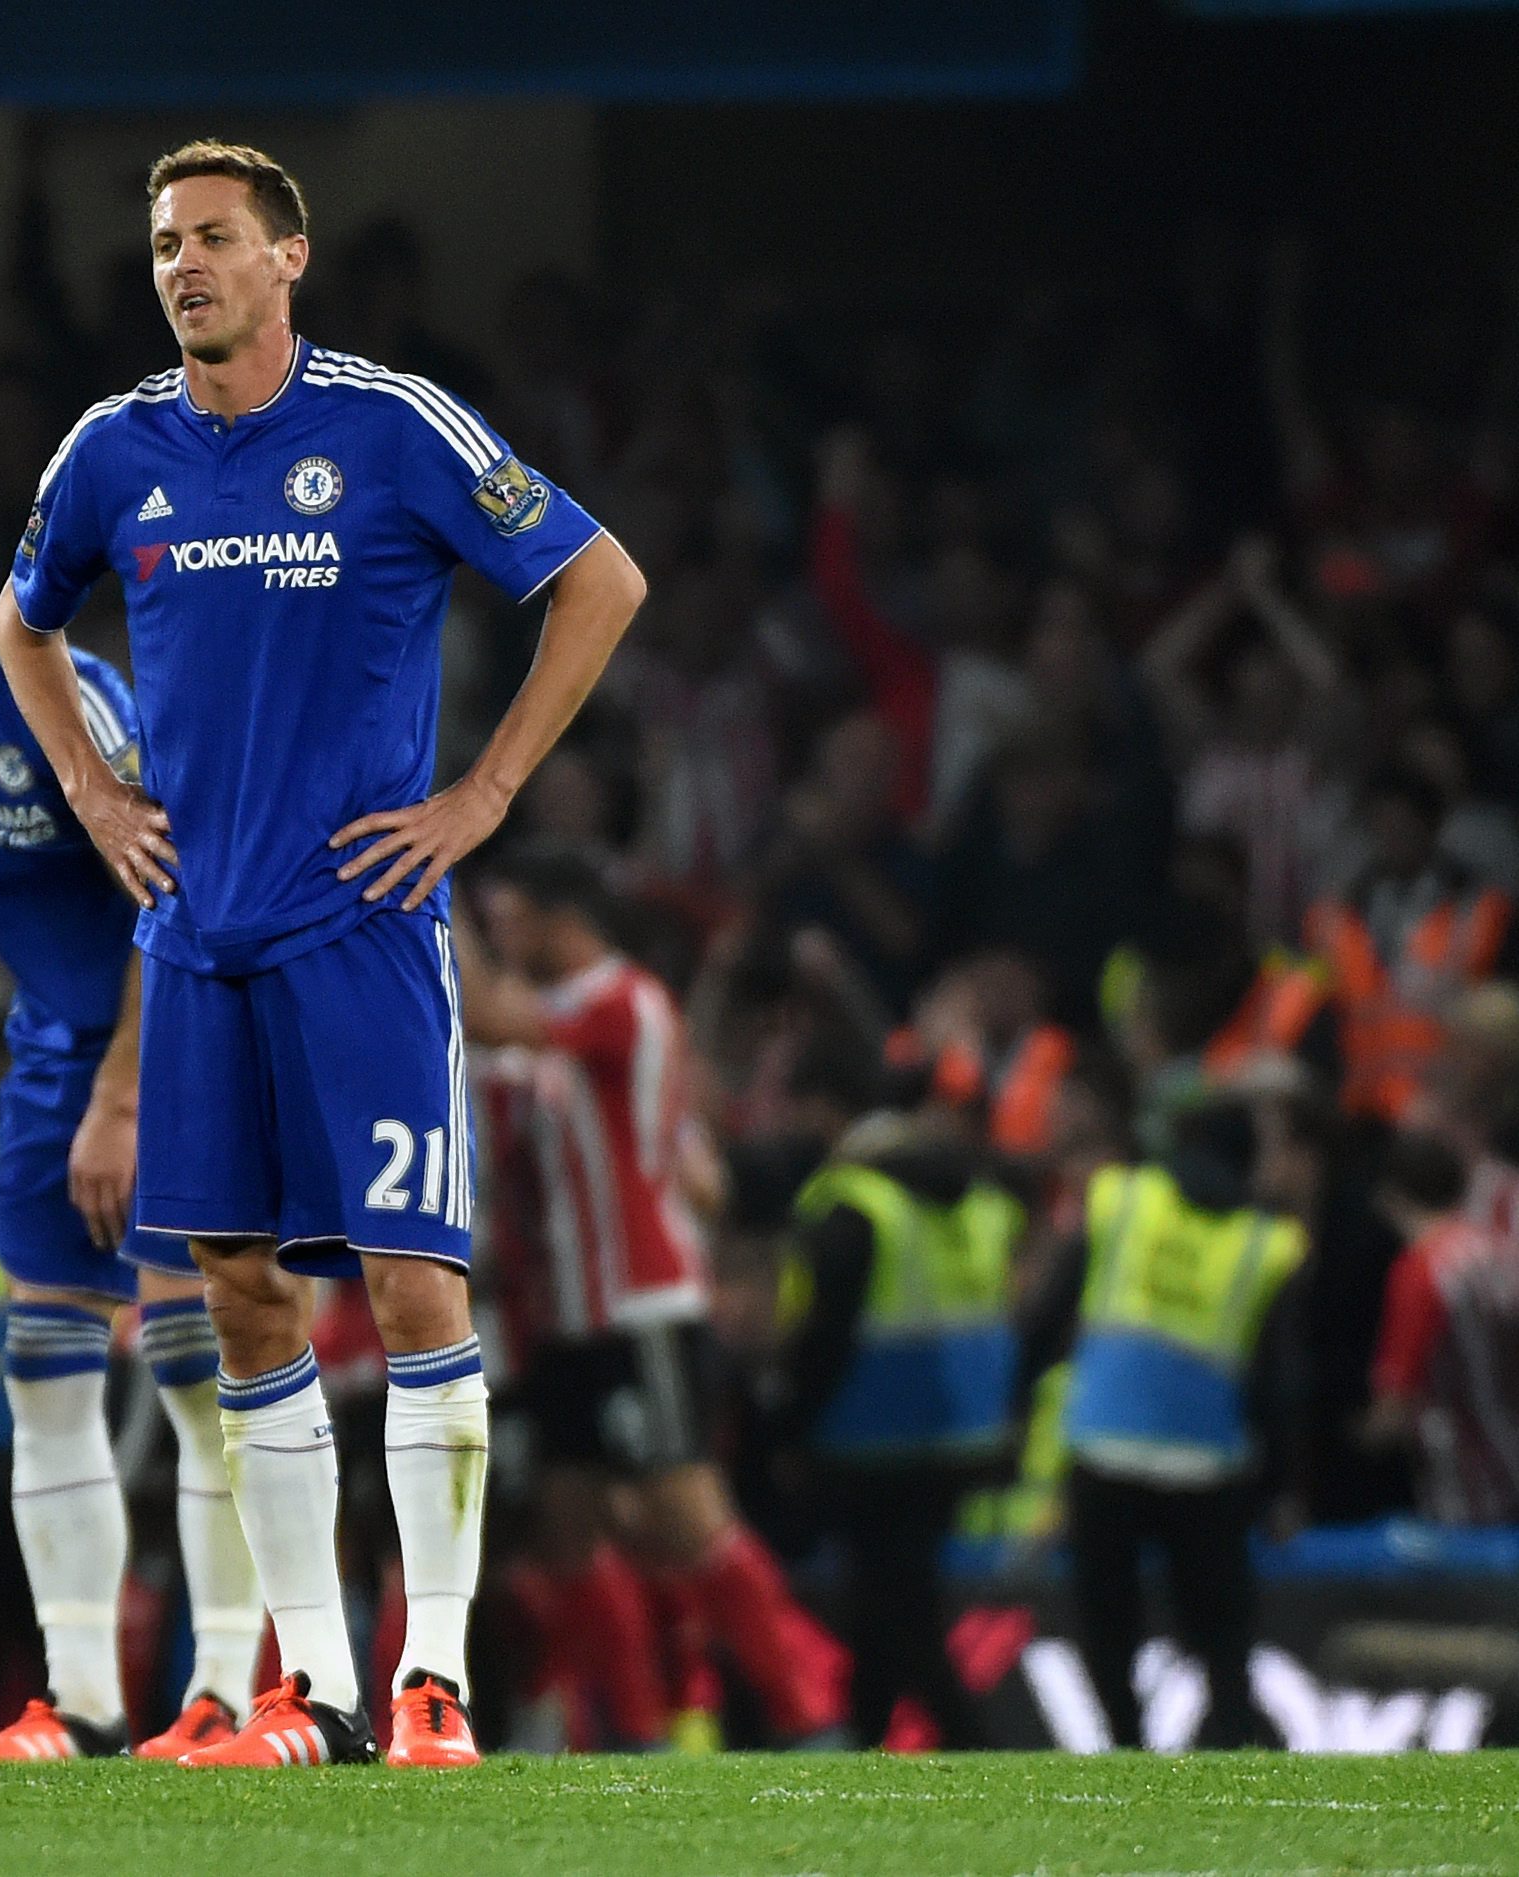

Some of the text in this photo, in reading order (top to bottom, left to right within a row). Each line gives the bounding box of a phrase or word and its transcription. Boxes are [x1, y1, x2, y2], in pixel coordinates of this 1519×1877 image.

[295, 459, 332, 473] CHELSEA
[137, 504, 173, 522] adidas
[169, 532, 341, 573] YOKOHAMA
[263, 566, 340, 589] TYRES
[364, 1118, 444, 1214] 21
